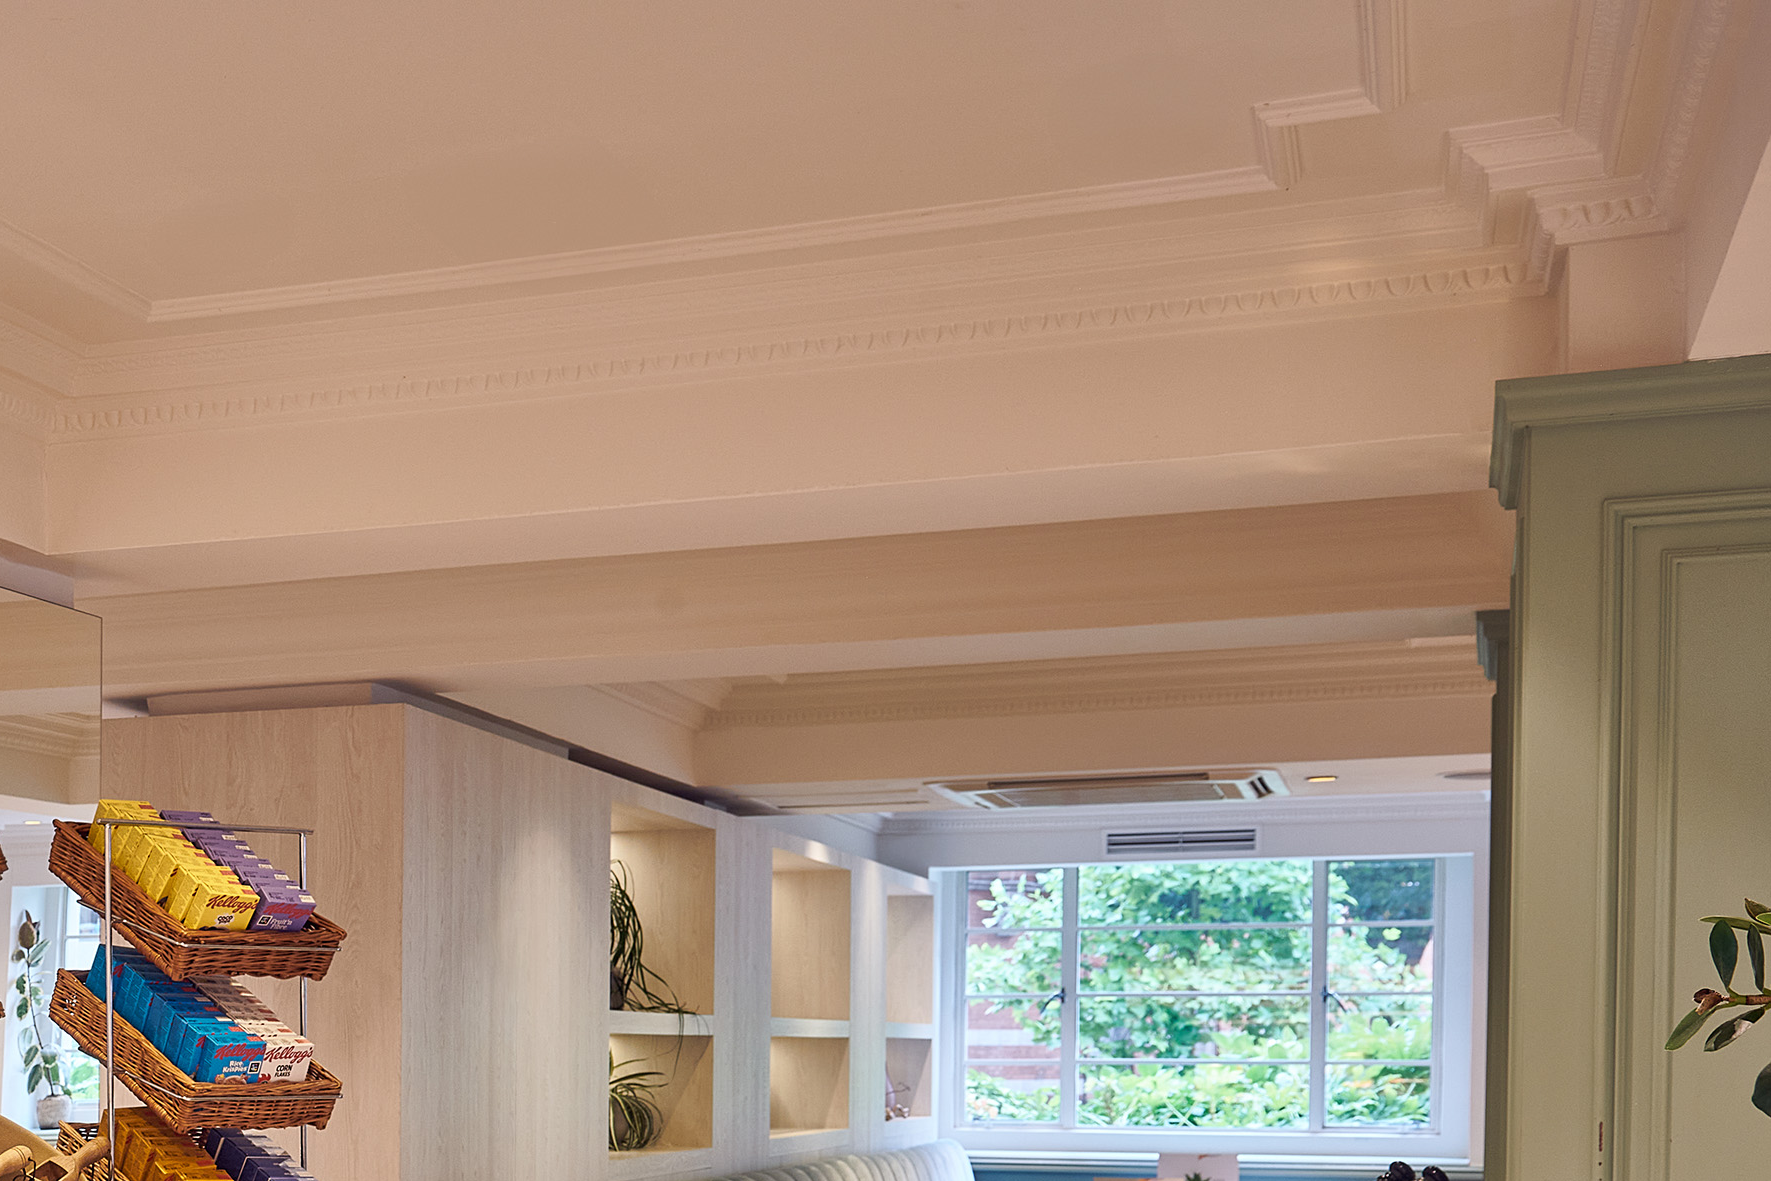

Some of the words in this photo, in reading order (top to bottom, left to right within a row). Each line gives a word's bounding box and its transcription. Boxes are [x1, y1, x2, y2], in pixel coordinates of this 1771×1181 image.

[206, 894, 258, 914] Kellogg's
[214, 1042, 267, 1062] Kellogg's
[263, 1046, 314, 1064] Kellogg's
